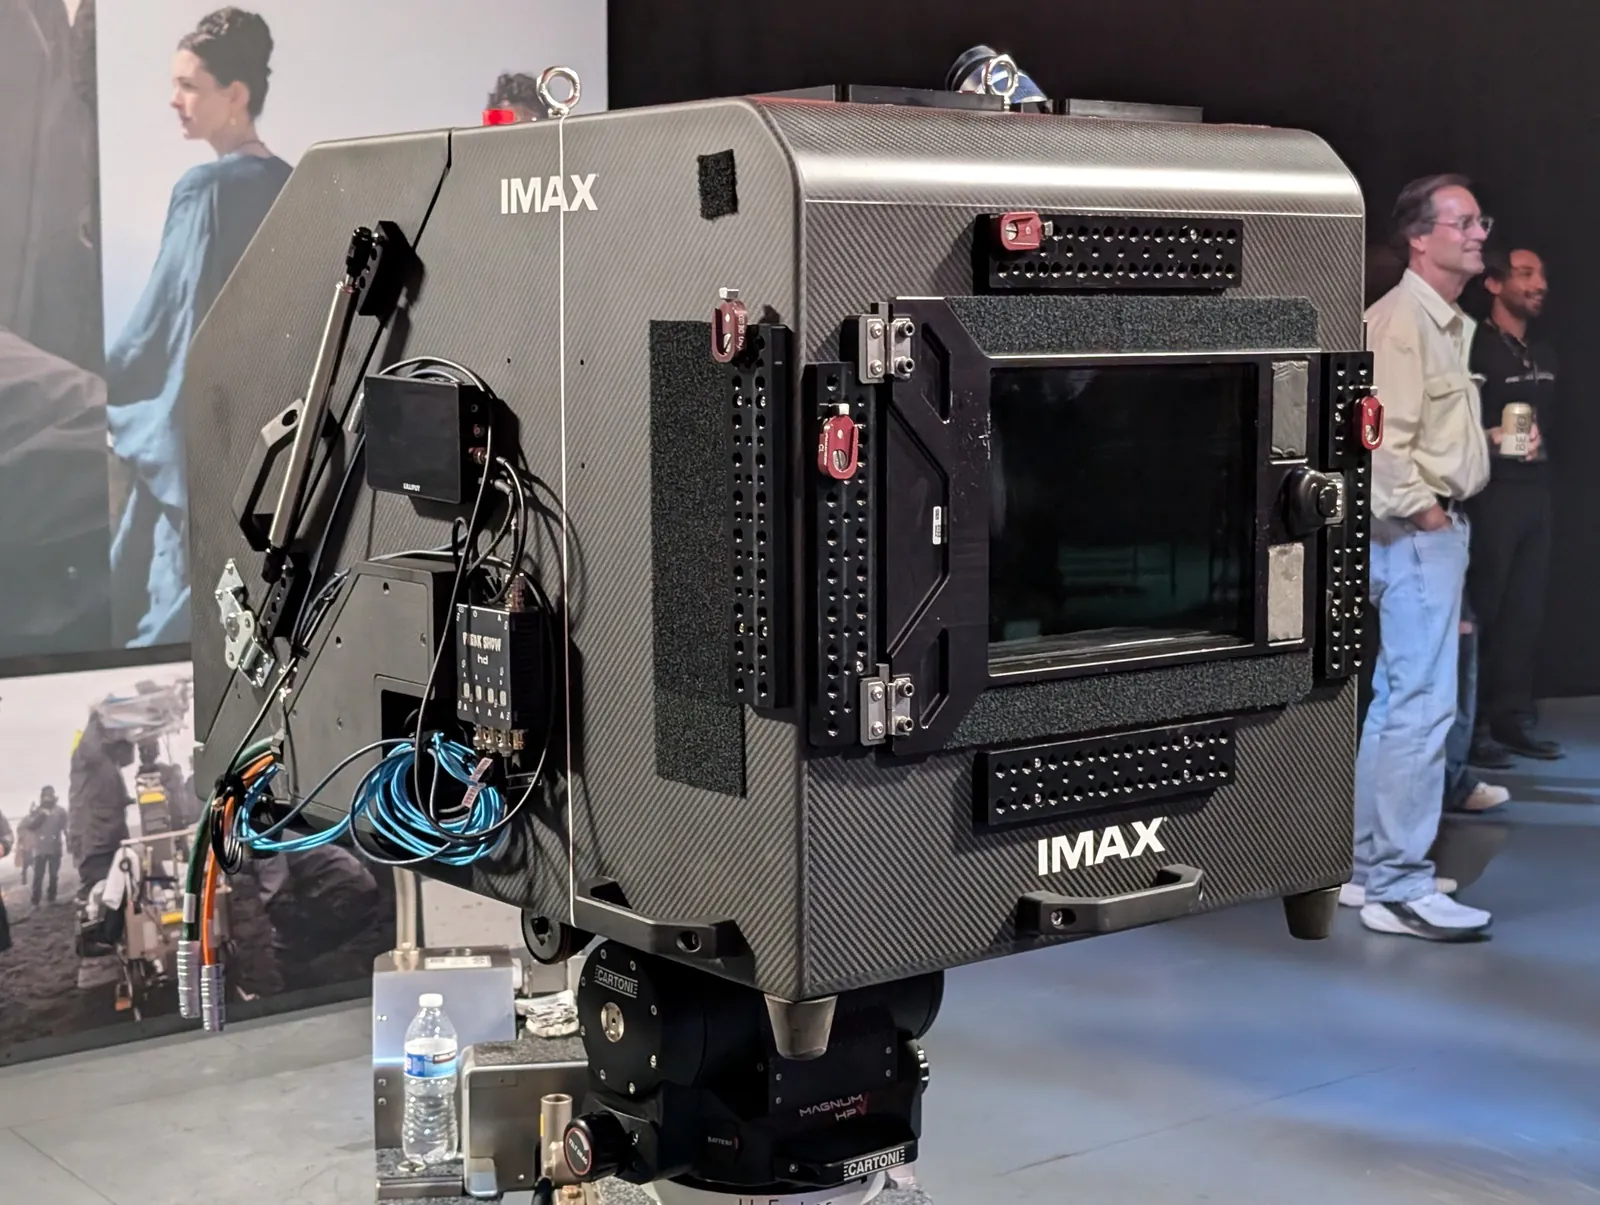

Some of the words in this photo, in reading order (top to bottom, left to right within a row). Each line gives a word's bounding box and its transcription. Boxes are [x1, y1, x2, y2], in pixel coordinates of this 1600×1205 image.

[501, 174, 598, 214] IMAX
[1038, 816, 1166, 876] IMAX
[597, 969, 634, 994] CARTONI
[799, 1094, 863, 1117] MAGNUM
[847, 1150, 900, 1176] CARTONI
